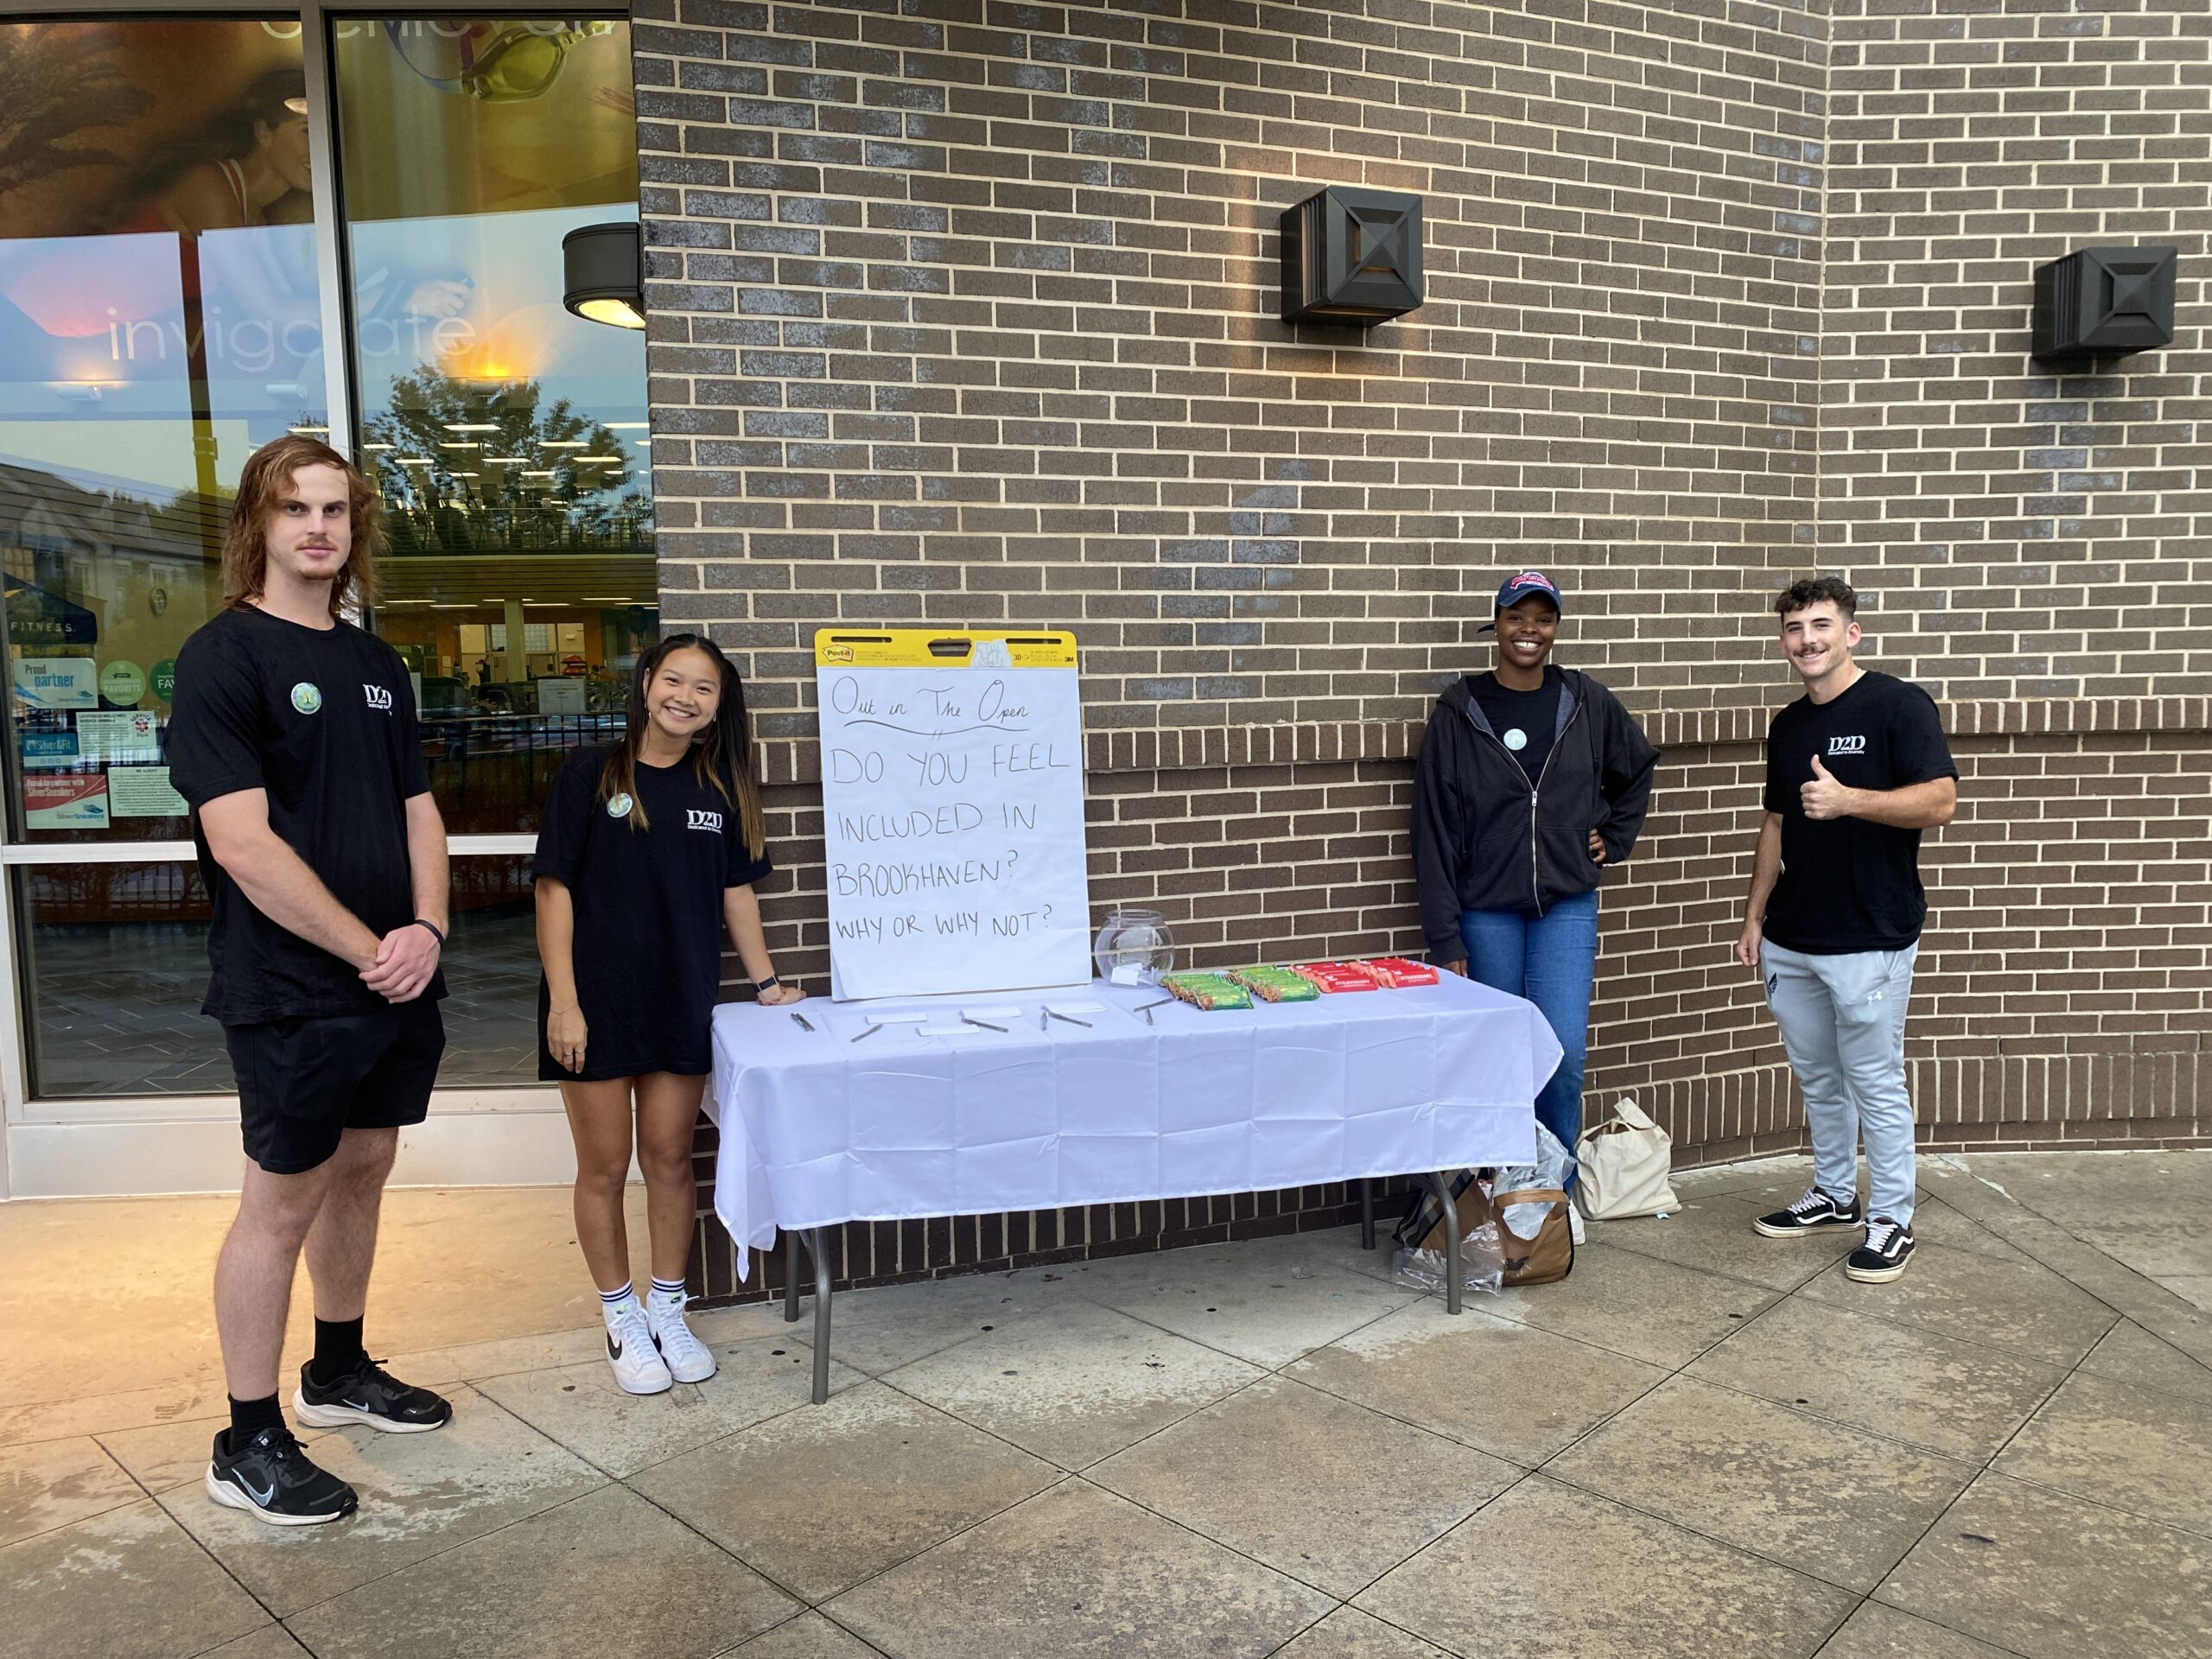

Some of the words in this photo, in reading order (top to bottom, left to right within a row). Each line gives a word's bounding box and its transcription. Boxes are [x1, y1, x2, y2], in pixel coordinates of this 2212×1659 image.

[106, 305, 477, 372] invigoate
[25, 664, 47, 675] Proud
[35, 672, 75, 691] partner
[104, 684, 143, 693] FAVORITE
[362, 683, 392, 709] D2D
[832, 676, 877, 715] Out
[888, 701, 907, 715] in
[917, 685, 962, 718] The
[978, 678, 1031, 724] Open
[1828, 735, 1866, 751] D2D
[830, 748, 885, 784] DO
[907, 751, 969, 787] YOU
[992, 742, 1071, 778] FEEL
[27, 787, 75, 798] SilverSneakers
[686, 810, 722, 829] D2D
[837, 802, 983, 843] INCLUDED
[1002, 802, 1037, 830] IN
[832, 849, 1020, 898] BROOKHAVEN?
[836, 916, 883, 944] WHY
[893, 913, 925, 938] OR
[935, 911, 979, 937] WHY
[993, 903, 1053, 937] NOT?
